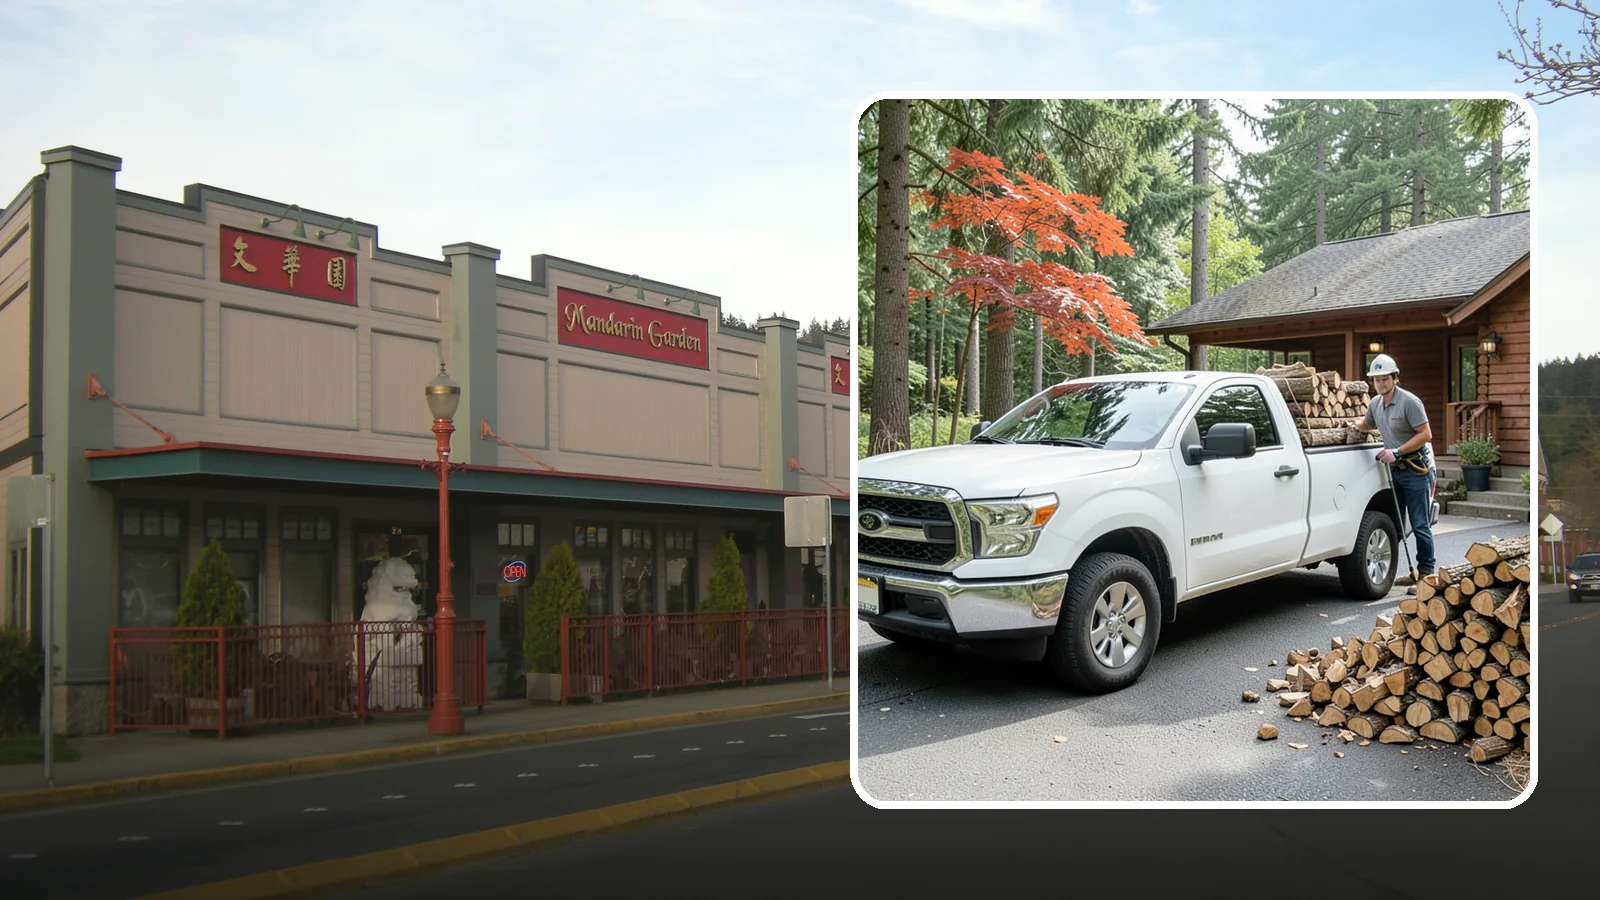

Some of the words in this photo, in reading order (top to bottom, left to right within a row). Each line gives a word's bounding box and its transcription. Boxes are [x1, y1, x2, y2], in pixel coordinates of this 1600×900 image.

[230, 235, 347, 291] 文華園
[564, 302, 644, 341] Mandarin
[647, 320, 702, 352] Garden
[503, 565, 527, 578] OPEN
